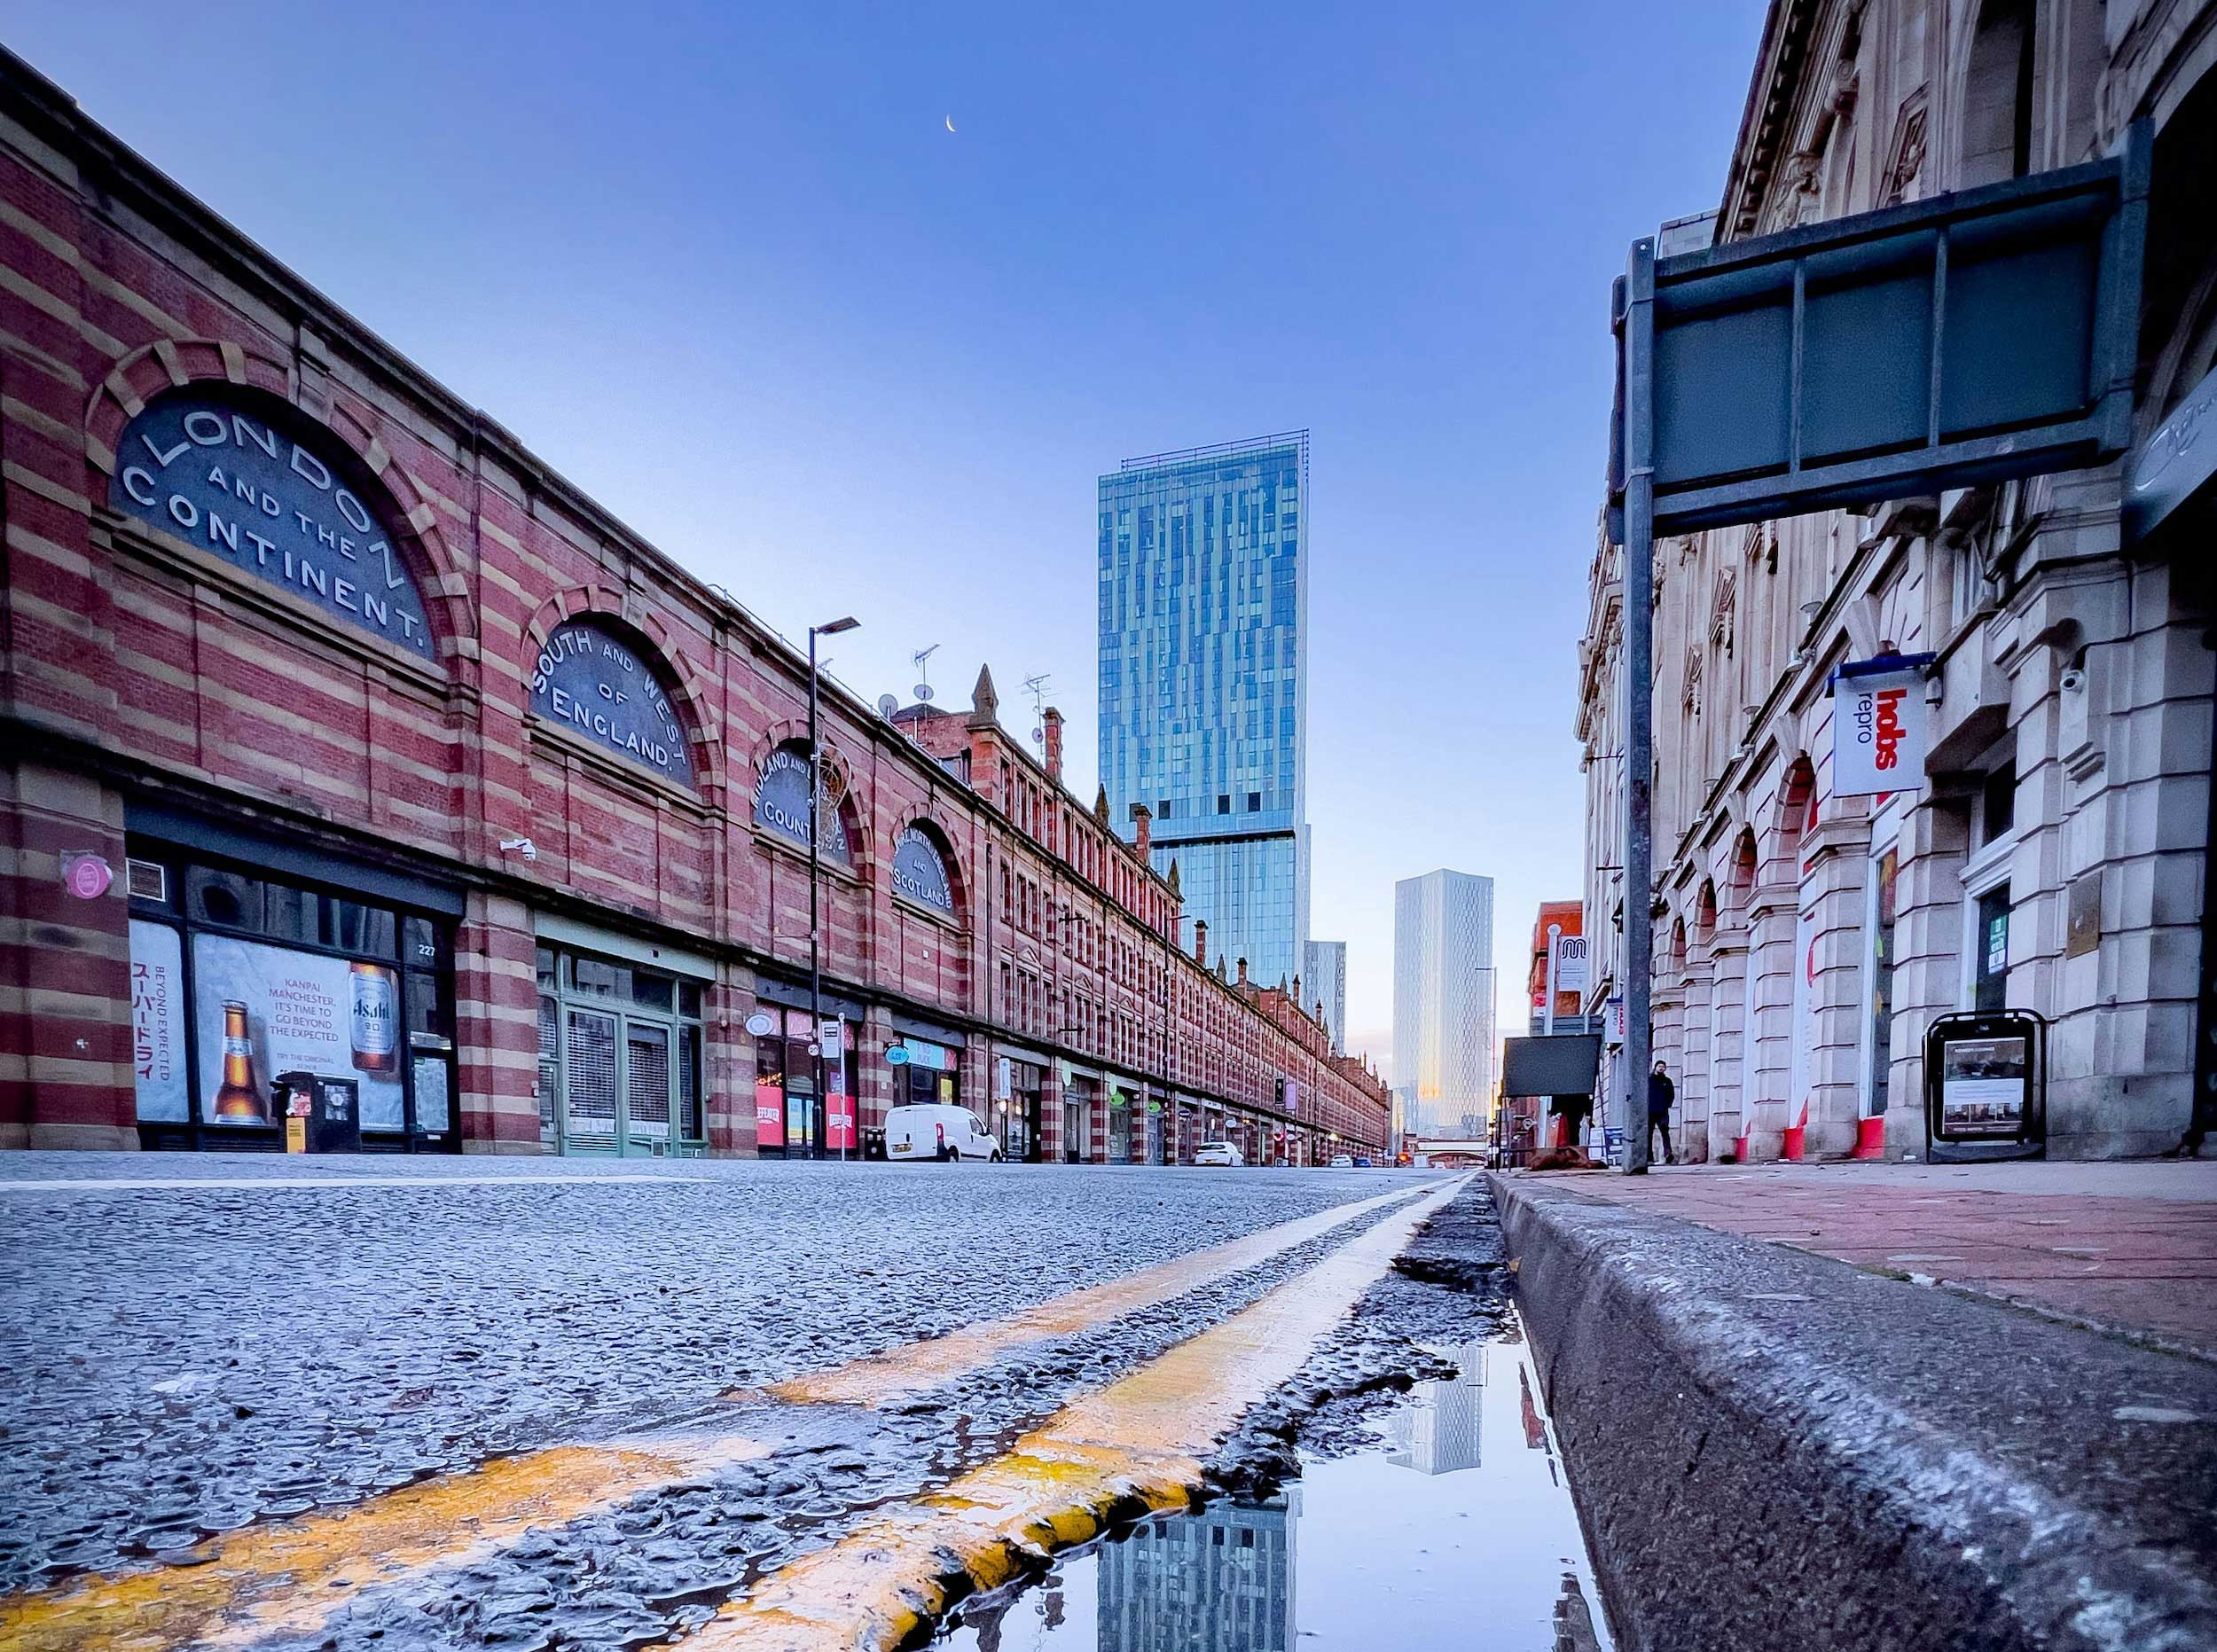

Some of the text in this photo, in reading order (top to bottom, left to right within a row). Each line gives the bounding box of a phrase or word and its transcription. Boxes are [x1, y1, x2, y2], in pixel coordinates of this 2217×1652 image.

[142, 411, 404, 590] LONDON
[208, 466, 356, 561] AND THE
[122, 466, 424, 647] CONTINENT.
[533, 630, 686, 765] SOUTH AND WEST
[599, 683, 629, 705] OF
[552, 687, 673, 771] ENGLAND.
[1853, 688, 1908, 771] hobs repro
[790, 757, 805, 774] AND
[894, 868, 944, 906] SCOTLAND
[419, 944, 435, 957] 227
[285, 978, 320, 992] KANPAI
[133, 962, 155, 1079] スーパードライ
[155, 966, 169, 1081] BEYOND EXPECTED
[275, 1002, 332, 1018] IT'S TIME TO
[276, 1014, 333, 1030] GO BEYOND
[353, 998, 389, 1020] Asahi
[270, 1025, 339, 1042] THE EXPECTED
